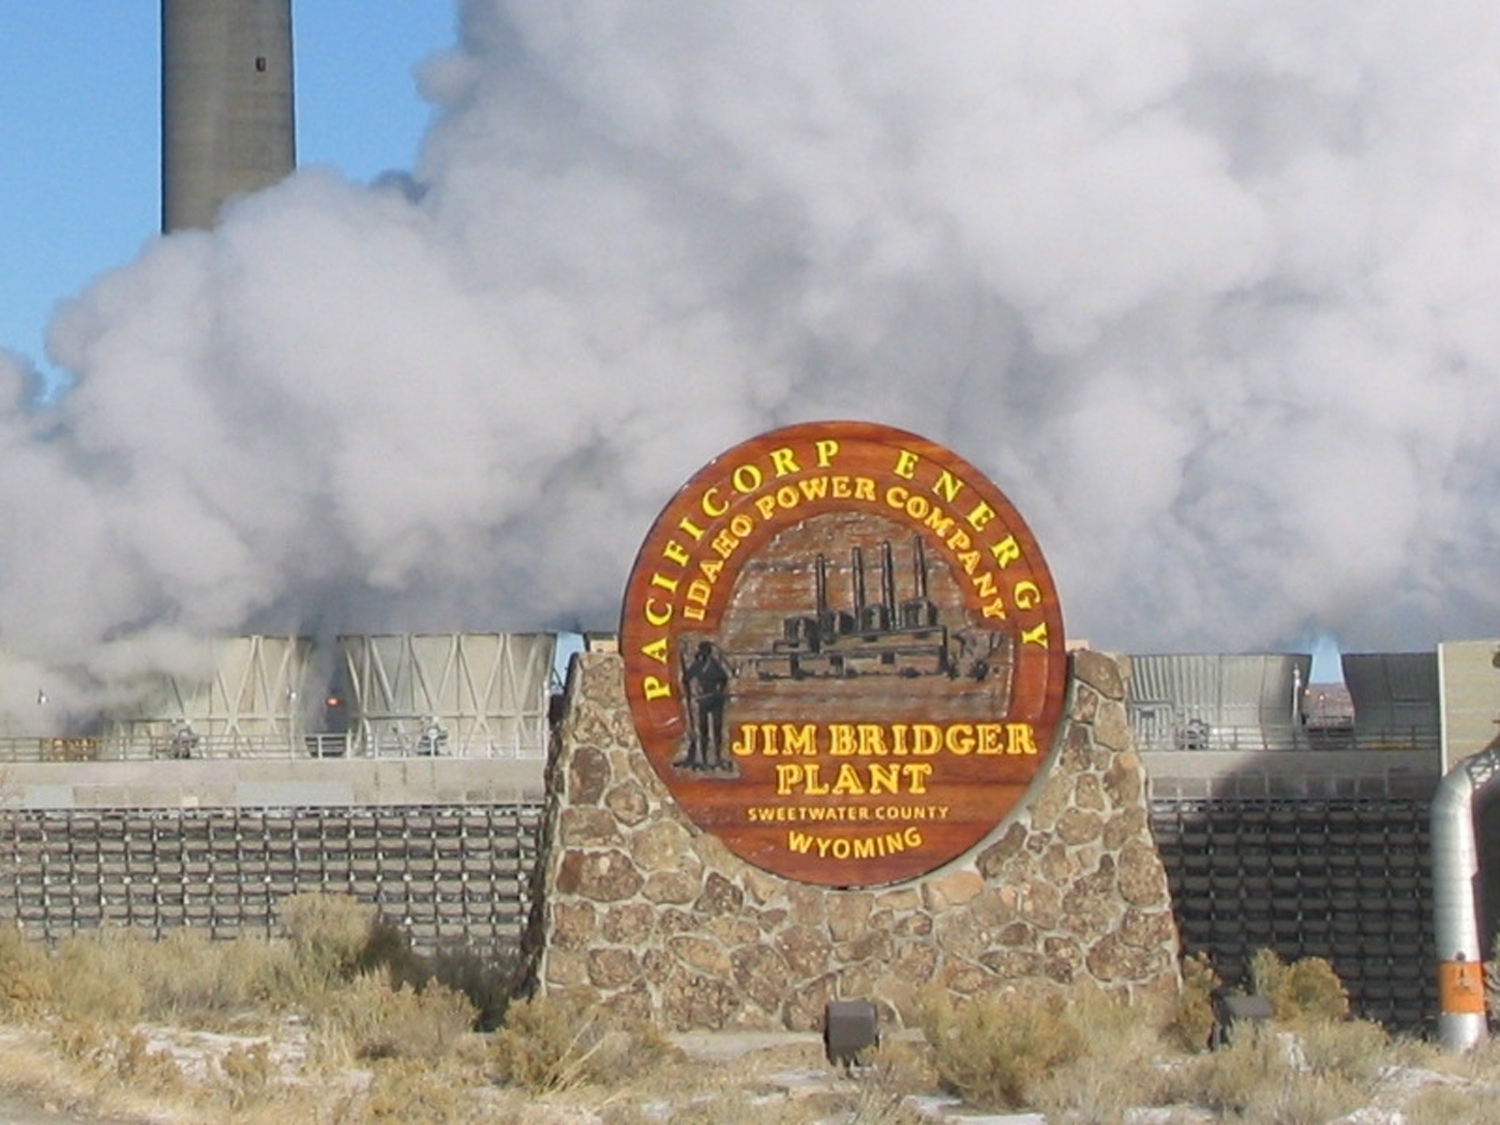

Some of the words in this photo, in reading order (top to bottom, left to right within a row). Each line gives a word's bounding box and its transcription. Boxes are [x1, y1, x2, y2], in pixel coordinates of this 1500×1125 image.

[683, 513, 754, 621] IDAHO
[755, 475, 877, 521] POWER
[886, 487, 1006, 621] COMPANY
[641, 440, 840, 701] PACIFICORP
[894, 449, 1049, 649] ENERGY
[732, 724, 819, 757] JIM
[828, 723, 1038, 756] BRIDGER
[775, 763, 934, 796] PLANT
[748, 807, 871, 822] SWEETWATER
[875, 805, 950, 820] COUNTY
[787, 826, 923, 860] WYOMING
